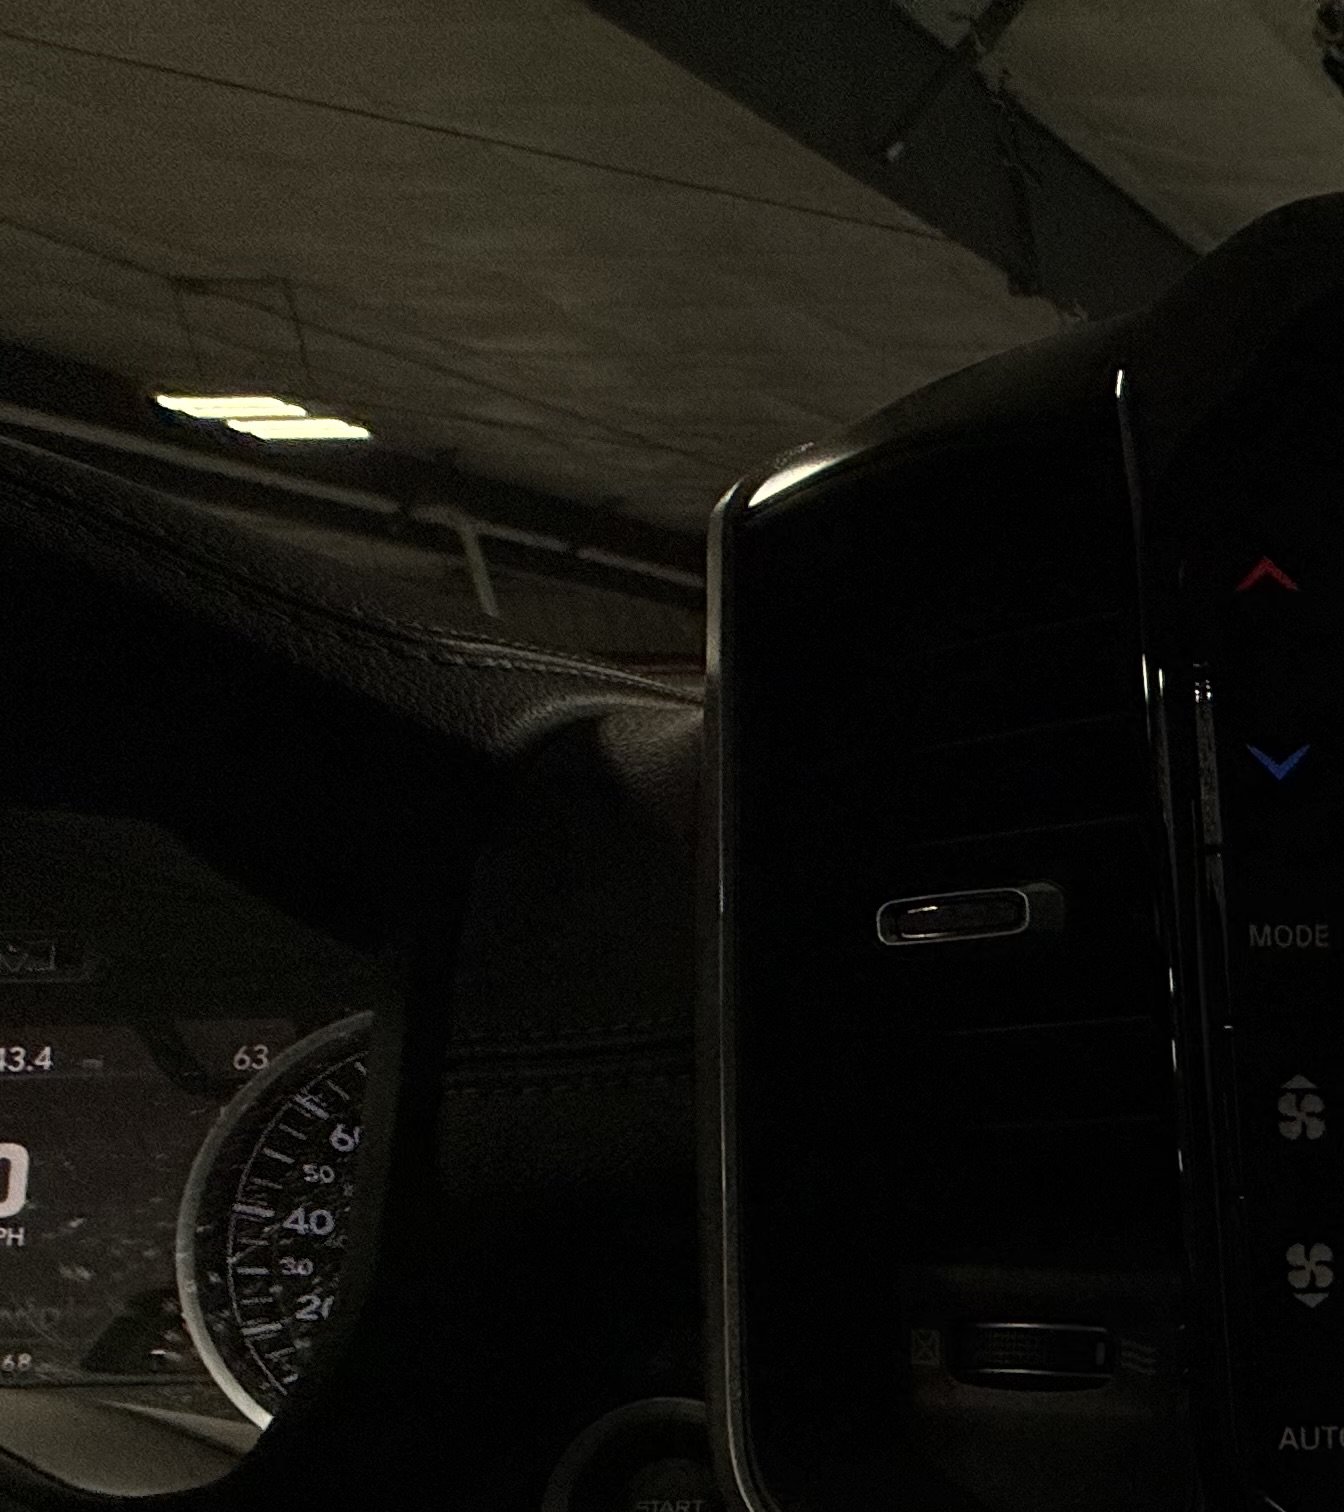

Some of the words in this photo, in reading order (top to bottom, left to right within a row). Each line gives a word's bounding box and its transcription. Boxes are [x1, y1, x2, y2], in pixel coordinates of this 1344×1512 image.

[1248, 923, 1330, 950] MODE
[232, 1044, 270, 1071] 63
[301, 1162, 336, 1185] 50
[281, 1205, 336, 1237] 40
[278, 1255, 315, 1278] 30
